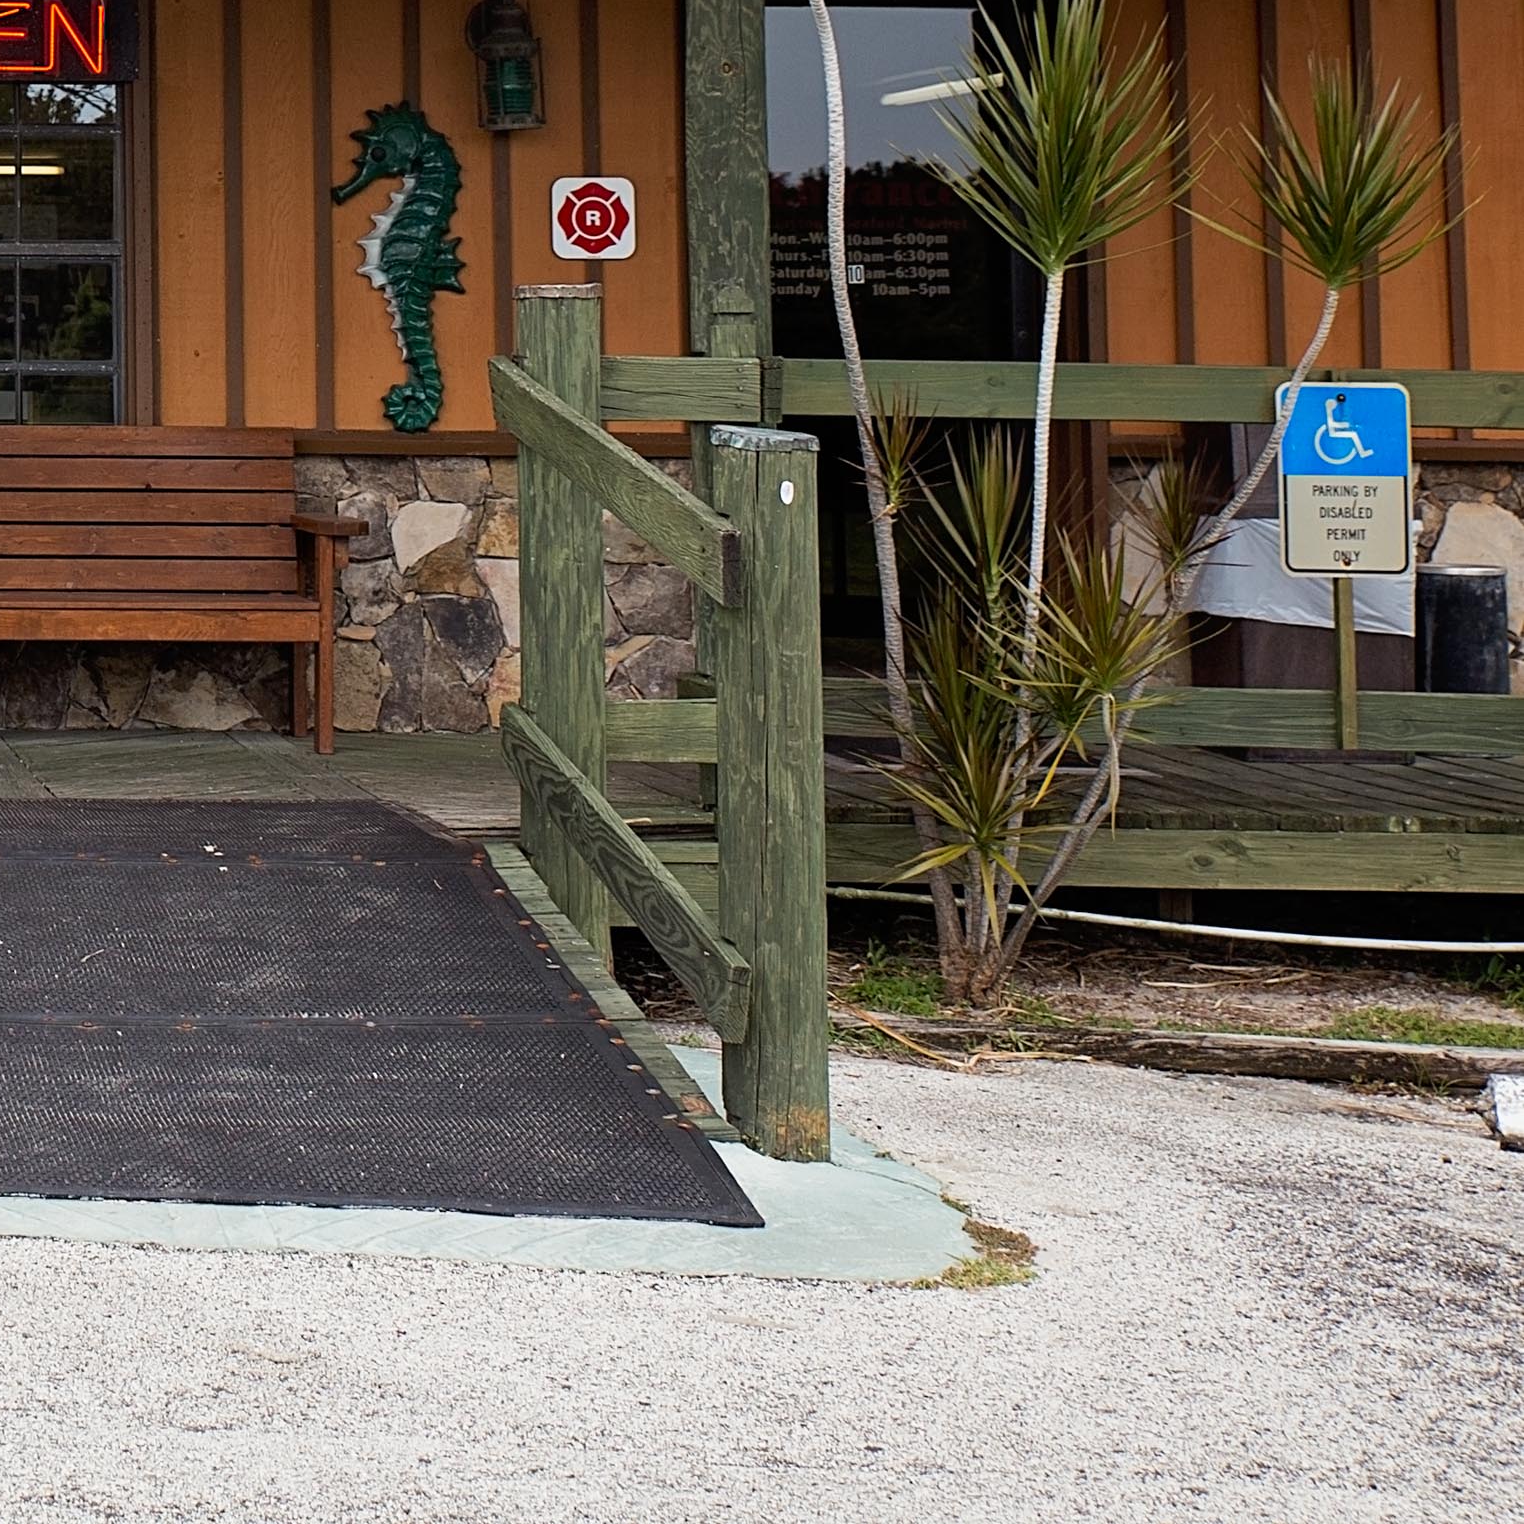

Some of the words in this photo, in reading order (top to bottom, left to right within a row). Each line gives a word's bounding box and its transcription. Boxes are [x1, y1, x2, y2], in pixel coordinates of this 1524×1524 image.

[585, 209, 601, 226] R
[1312, 484, 1358, 497] PARKING
[1364, 485, 1378, 497] BY
[1319, 506, 1373, 519] DISABLED
[1326, 528, 1366, 540] PERMIT
[1333, 550, 1360, 564] ONLY
